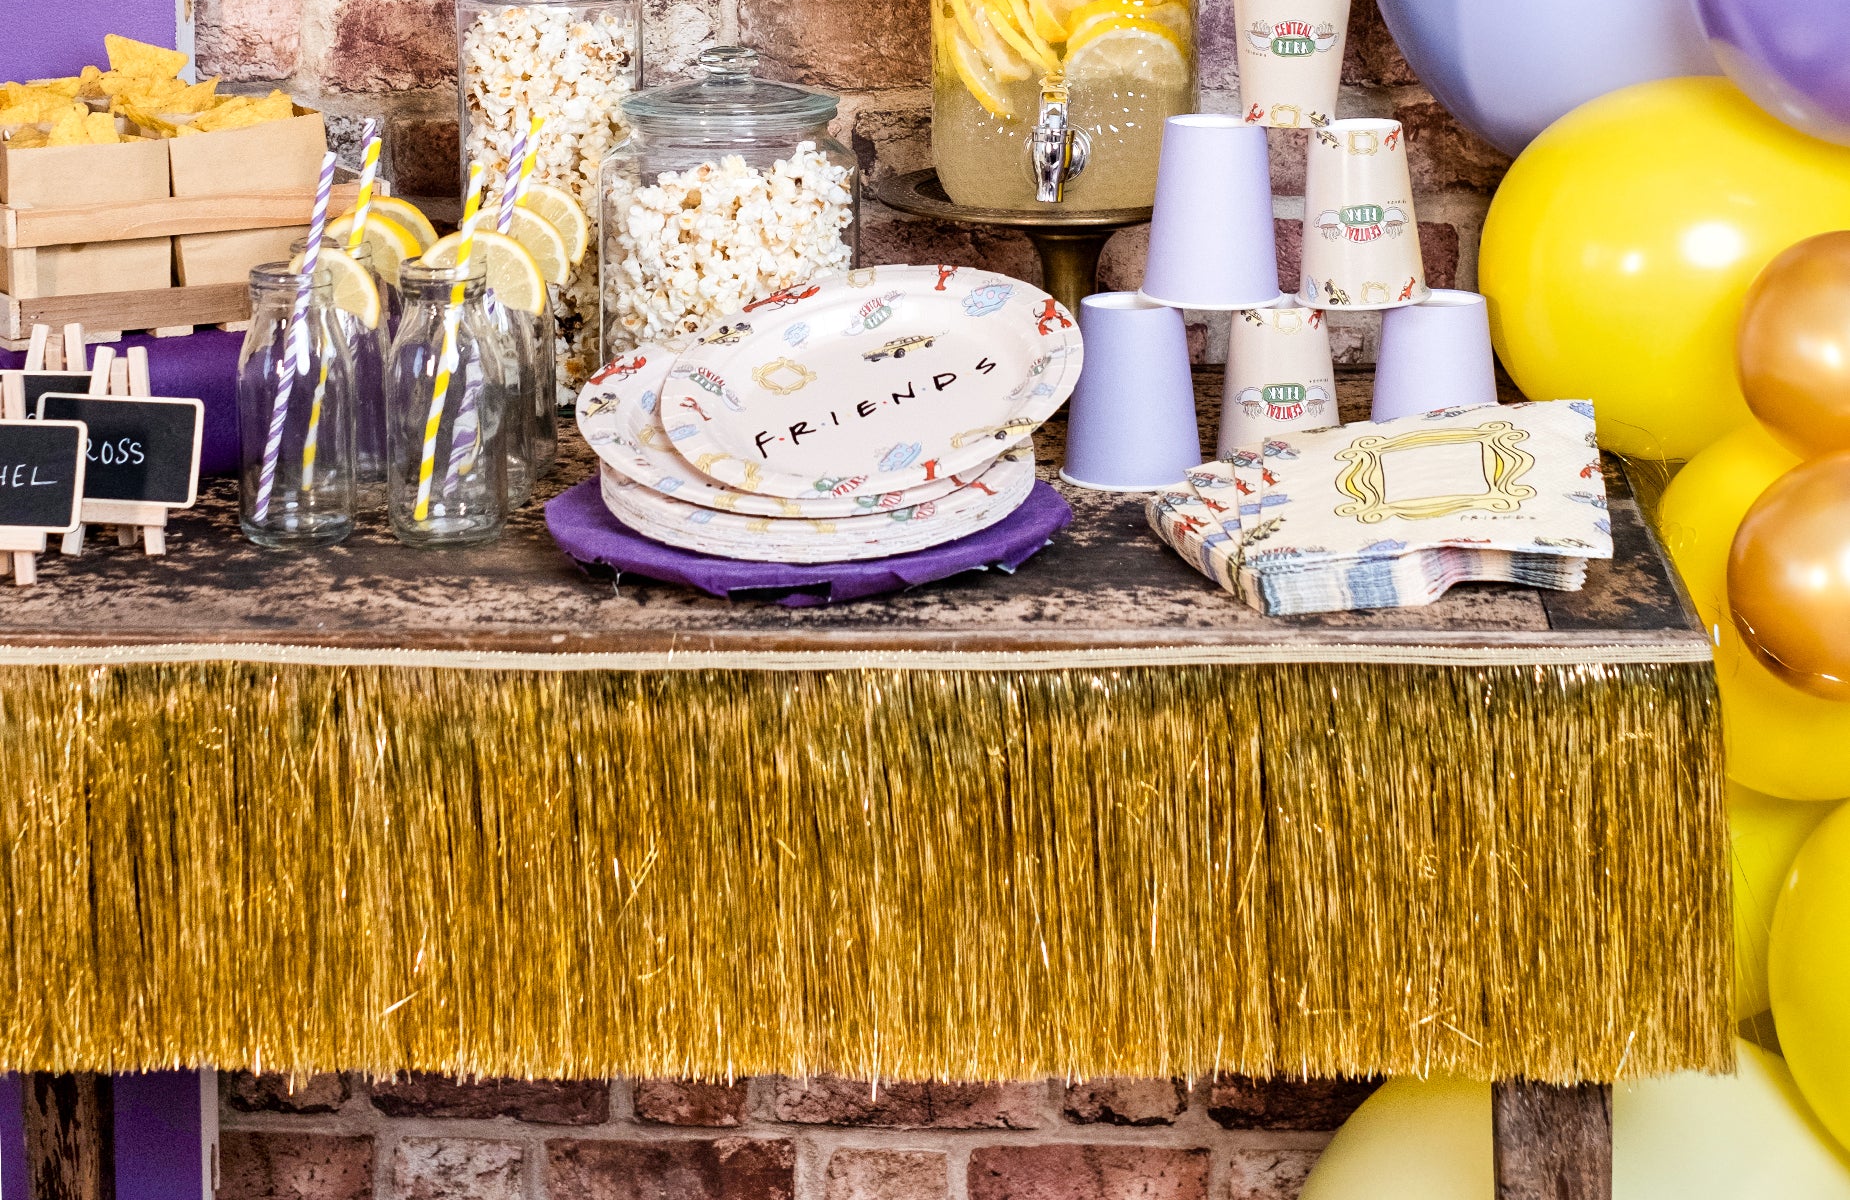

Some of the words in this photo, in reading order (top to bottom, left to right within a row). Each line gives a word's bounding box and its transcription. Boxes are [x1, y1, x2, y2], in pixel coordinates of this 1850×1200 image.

[1274, 21, 1312, 38] CENTRAL
[1277, 39, 1309, 54] PERK
[1345, 224, 1382, 241] CENTRAL
[1265, 402, 1304, 420] CENTRAL
